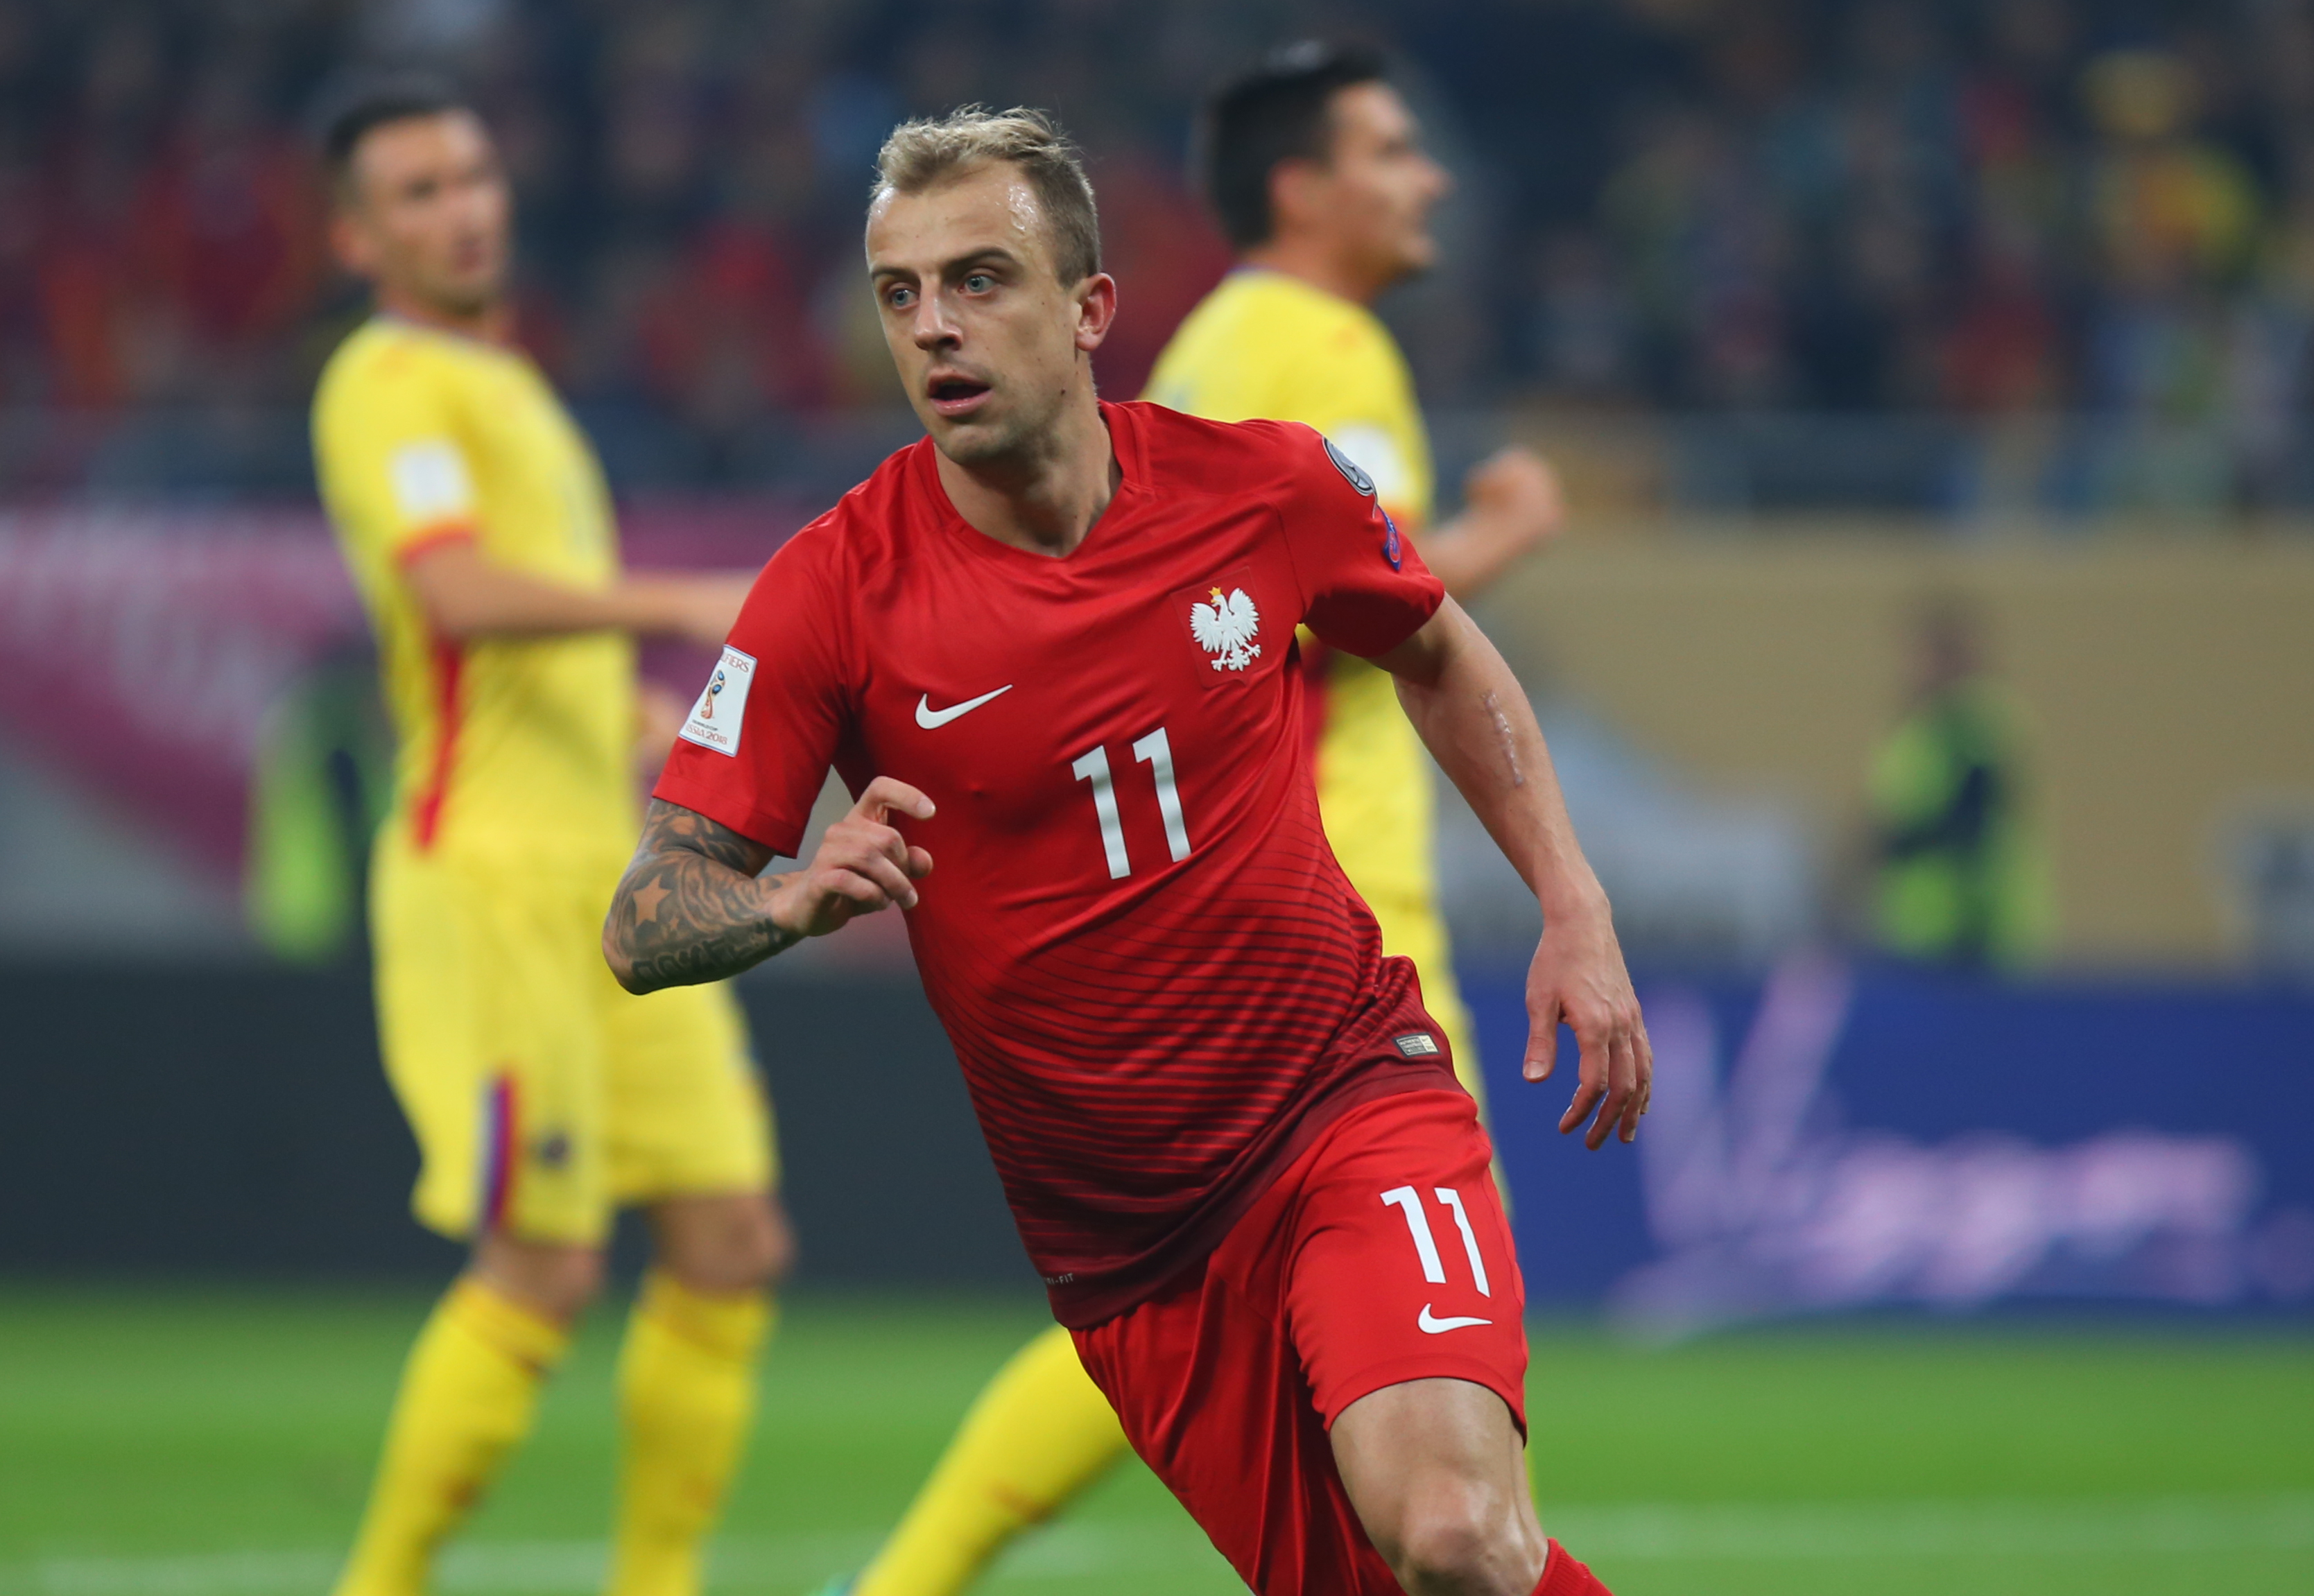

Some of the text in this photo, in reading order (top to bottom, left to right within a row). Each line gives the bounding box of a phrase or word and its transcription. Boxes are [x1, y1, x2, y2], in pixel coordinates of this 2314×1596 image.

[706, 731, 727, 745] 2018
[1072, 727, 1192, 880] 11
[1379, 1185, 1491, 1298] 11
